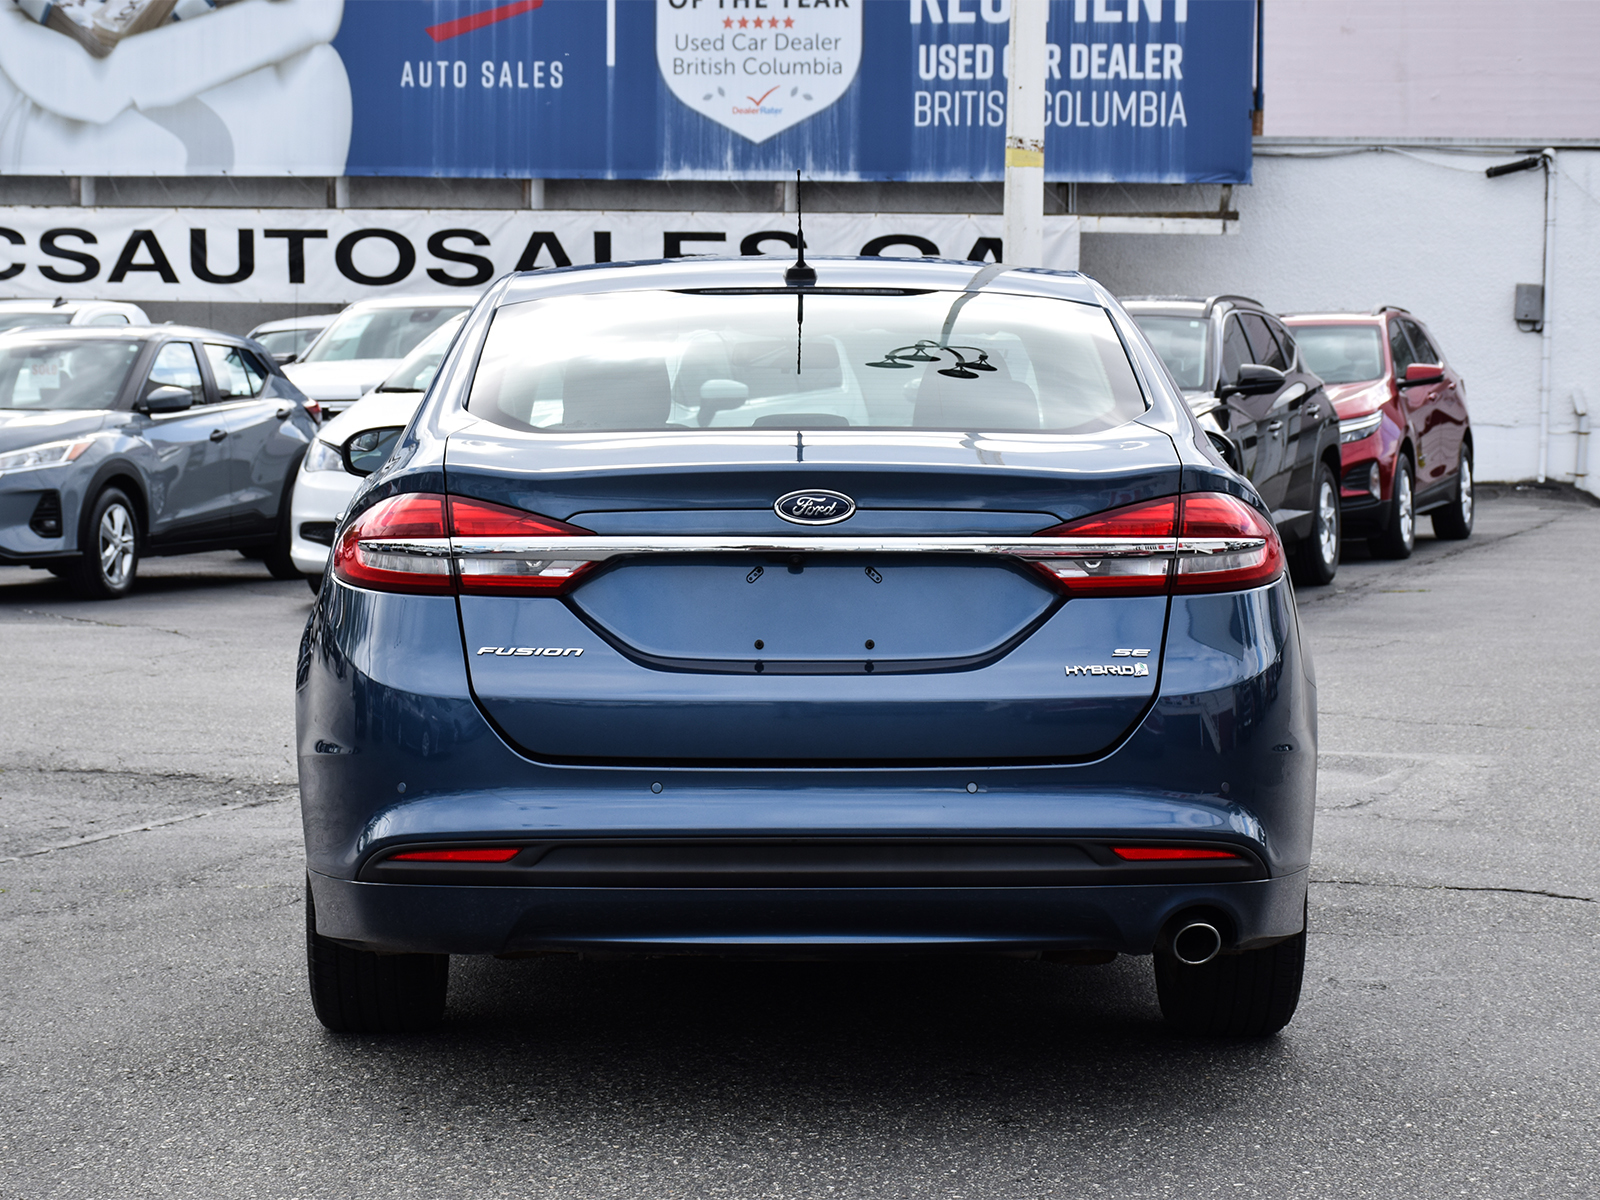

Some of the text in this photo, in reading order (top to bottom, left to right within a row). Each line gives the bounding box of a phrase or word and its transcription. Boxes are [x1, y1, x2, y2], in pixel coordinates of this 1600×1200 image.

[674, 33, 842, 51] Used Car Dealer
[672, 57, 843, 75] British Columbia
[918, 44, 994, 80] USED
[1070, 43, 1183, 80] DEALER
[400, 60, 564, 88] AUTO SALES
[914, 90, 1005, 127] BRITIS
[31, 364, 58, 376] SOLD
[792, 496, 837, 516] Ford
[477, 646, 584, 657] FUSION
[1111, 648, 1151, 658] SE
[1065, 665, 1135, 676] HYBRID
